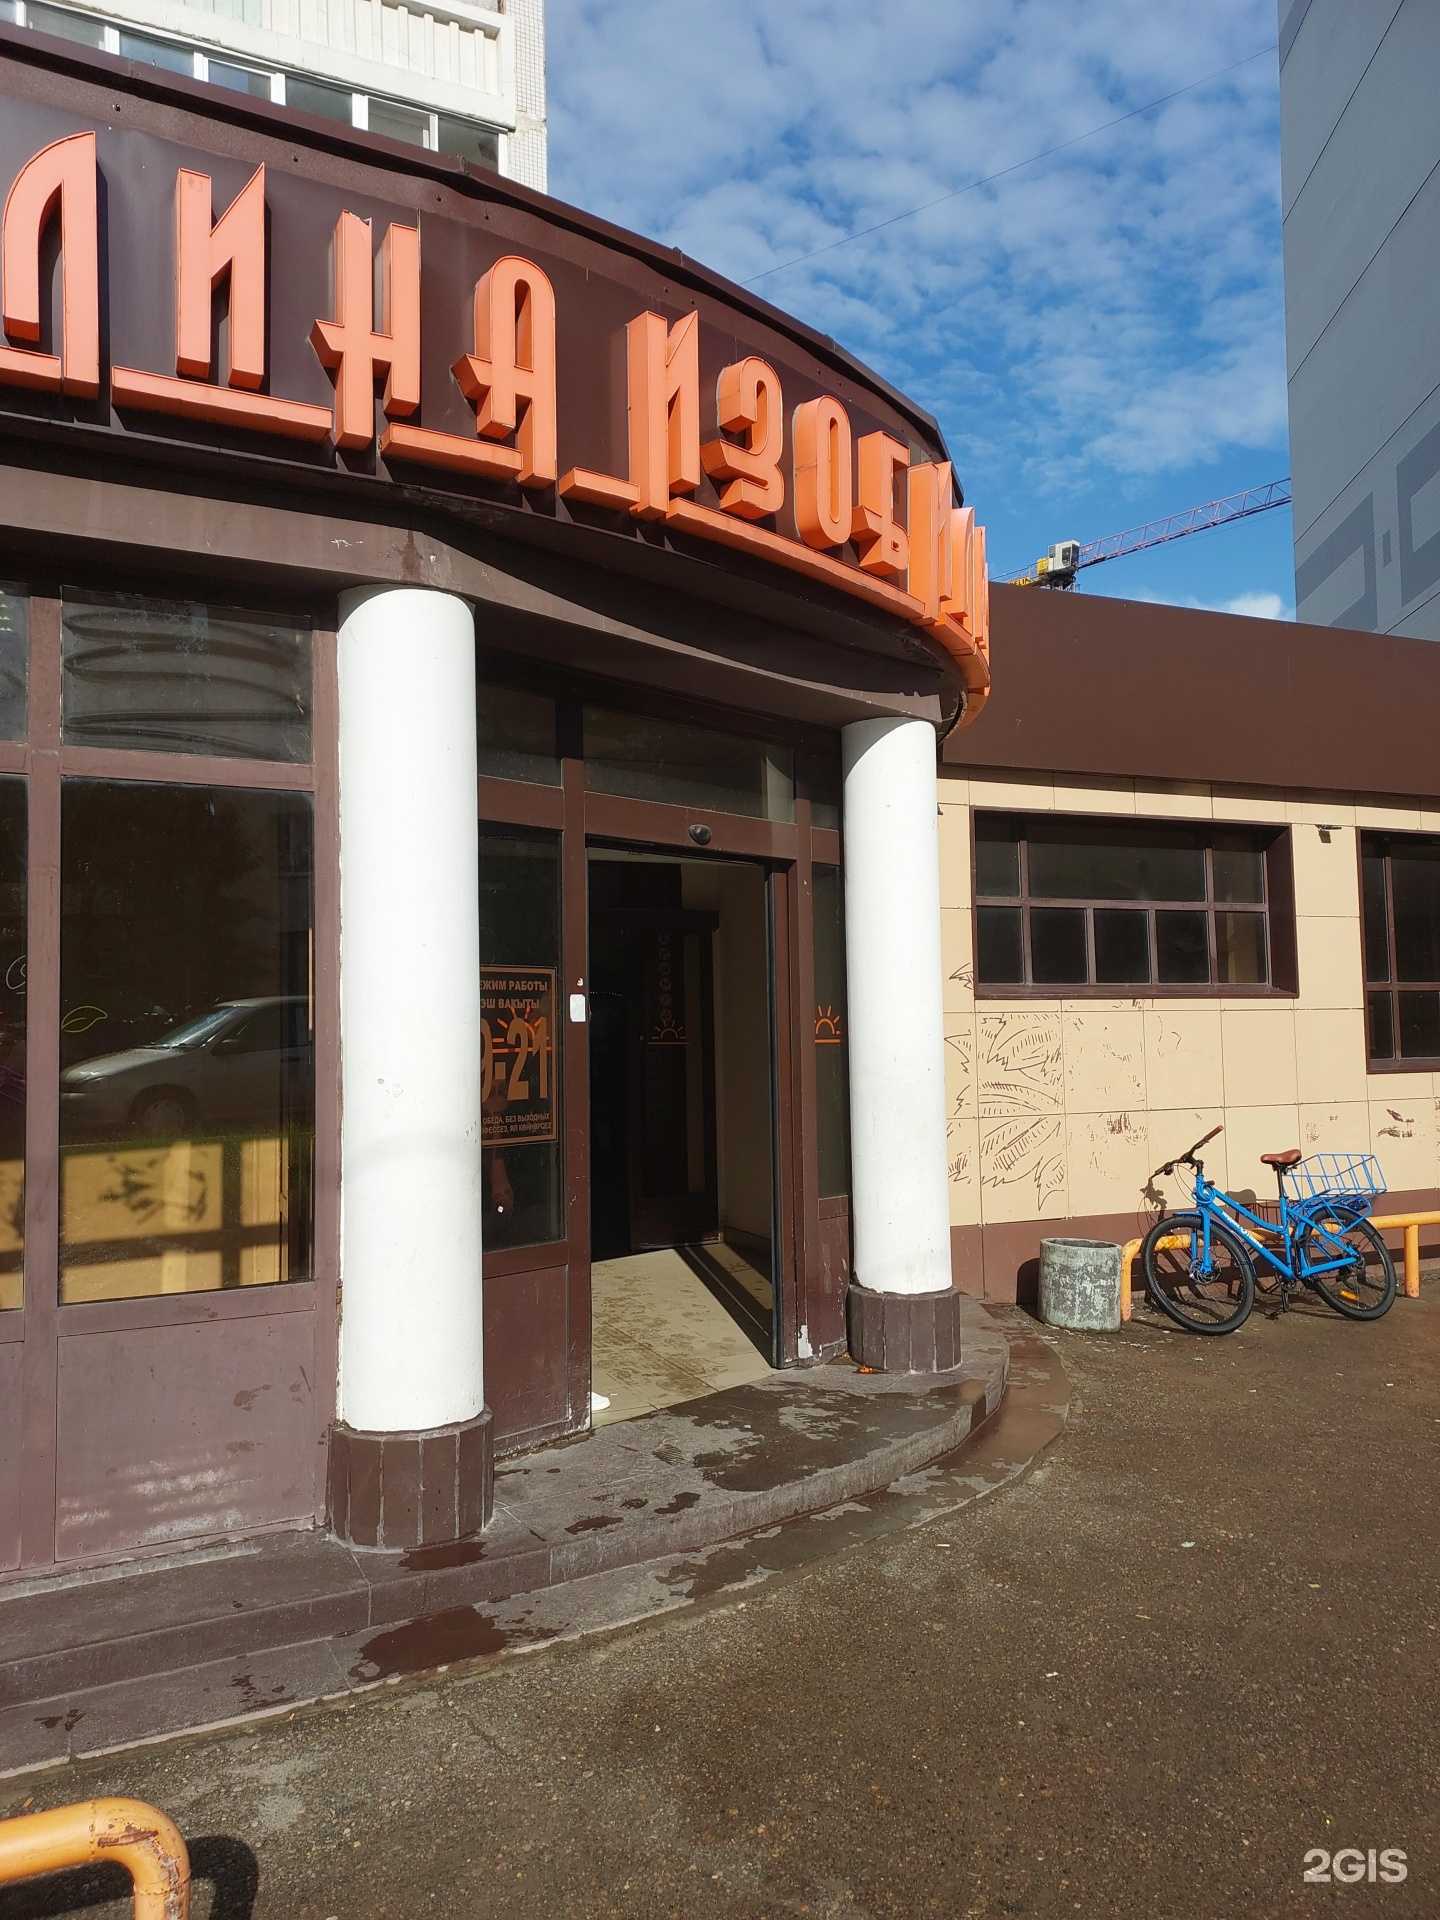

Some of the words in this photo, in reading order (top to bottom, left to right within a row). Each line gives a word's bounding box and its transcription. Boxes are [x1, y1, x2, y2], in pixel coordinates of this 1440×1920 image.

[626, 310, 990, 672] ИЗОБИЛ
[508, 980, 548, 991] РАБОТЫ
[498, 998, 540, 1009] ВАКЫТЫ
